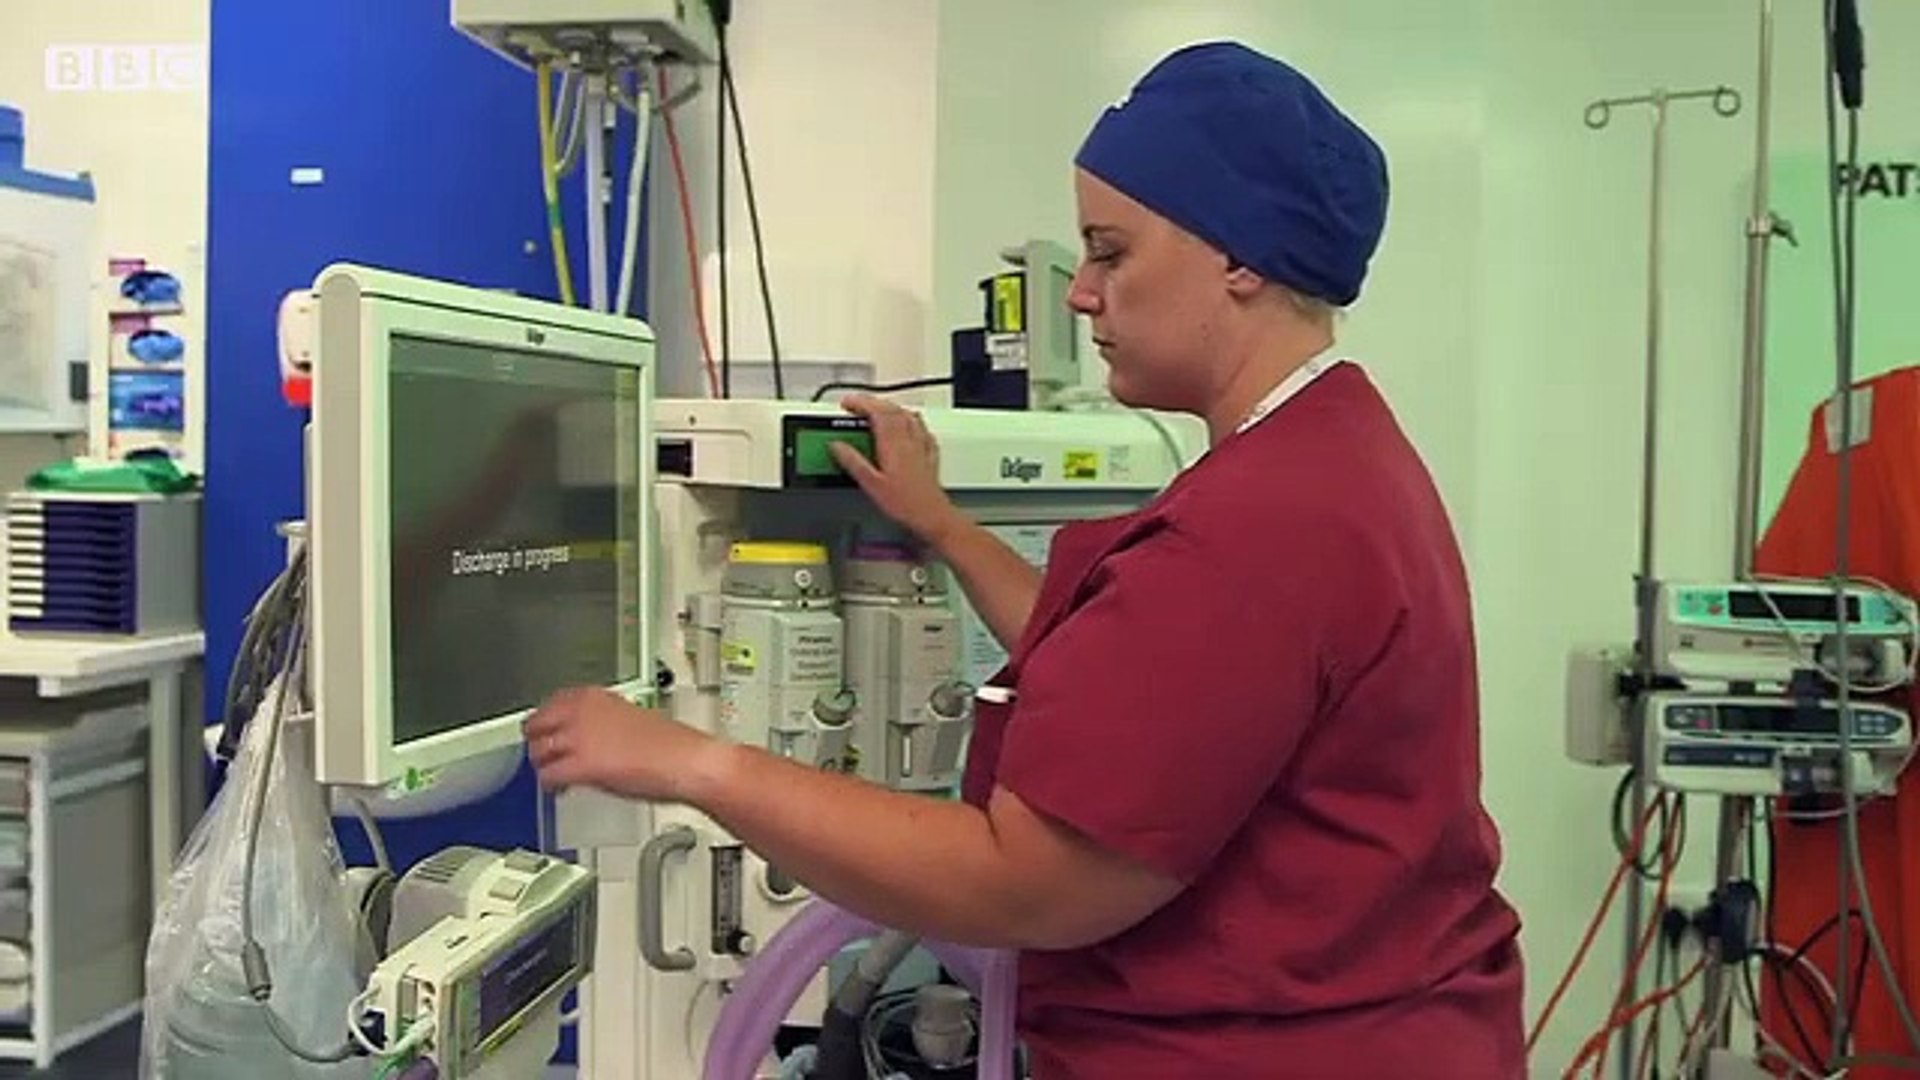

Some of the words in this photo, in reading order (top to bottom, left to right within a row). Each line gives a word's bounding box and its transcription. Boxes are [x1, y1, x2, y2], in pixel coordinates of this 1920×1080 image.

[1832, 162, 1920, 198] PAT
[452, 548, 510, 575] Discharge
[512, 546, 523, 568] in
[525, 545, 570, 572] progress
